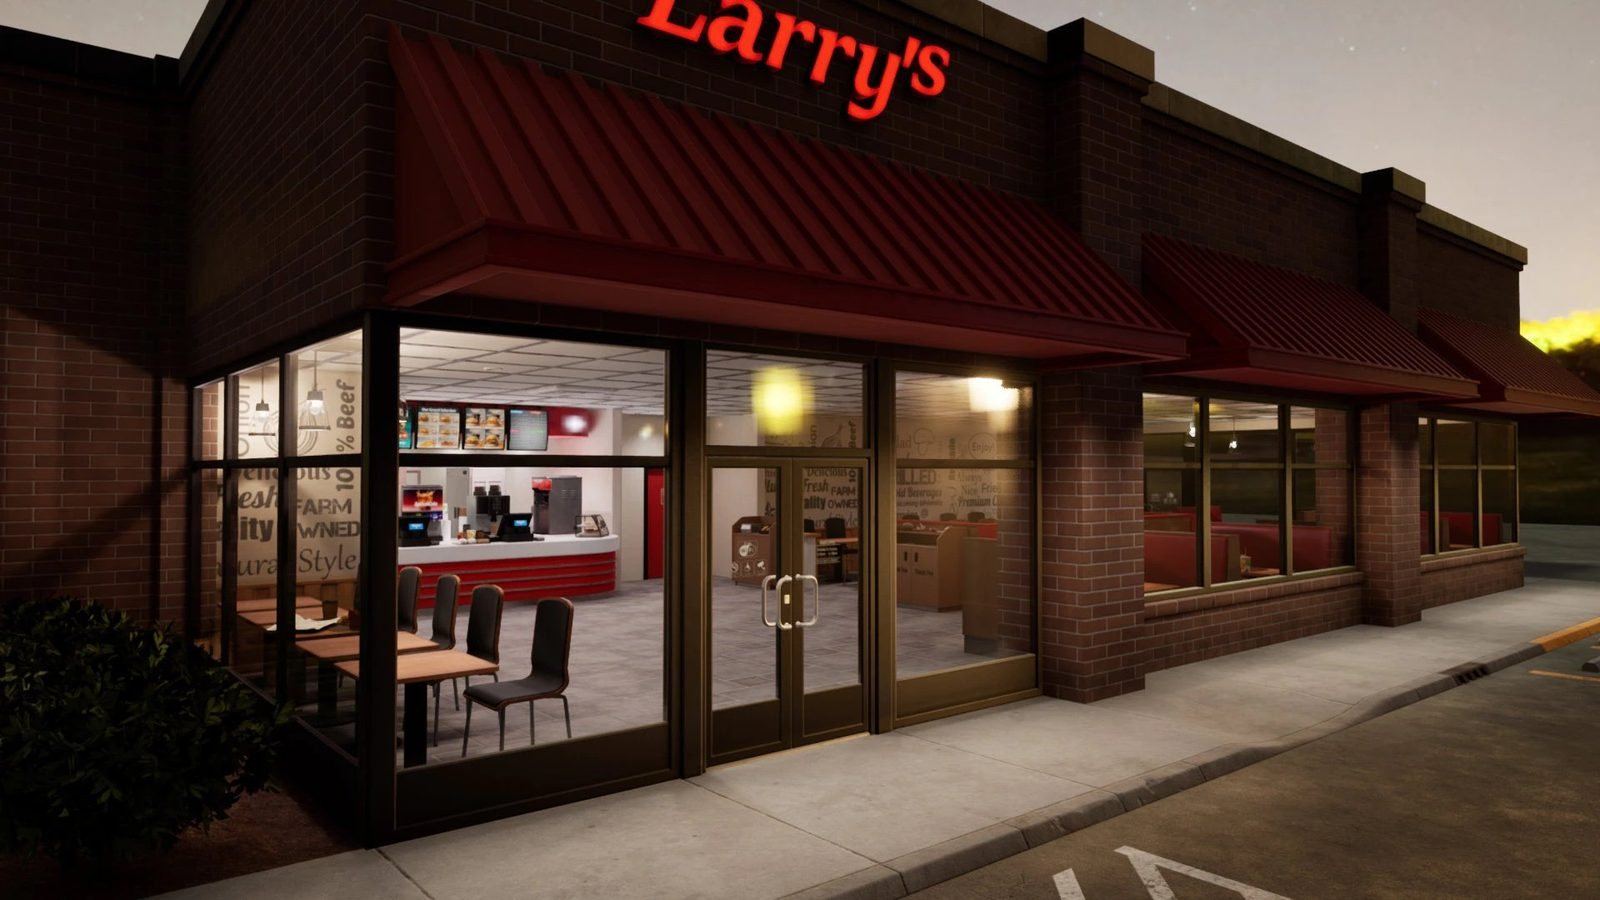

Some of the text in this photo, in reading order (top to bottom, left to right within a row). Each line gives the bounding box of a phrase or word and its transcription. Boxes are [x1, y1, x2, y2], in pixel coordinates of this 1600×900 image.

[637, 0, 950, 120] Larry's
[336, 379, 355, 430] Beef
[831, 486, 856, 496] FARM
[297, 521, 360, 538] WNED
[298, 544, 357, 579] Style
